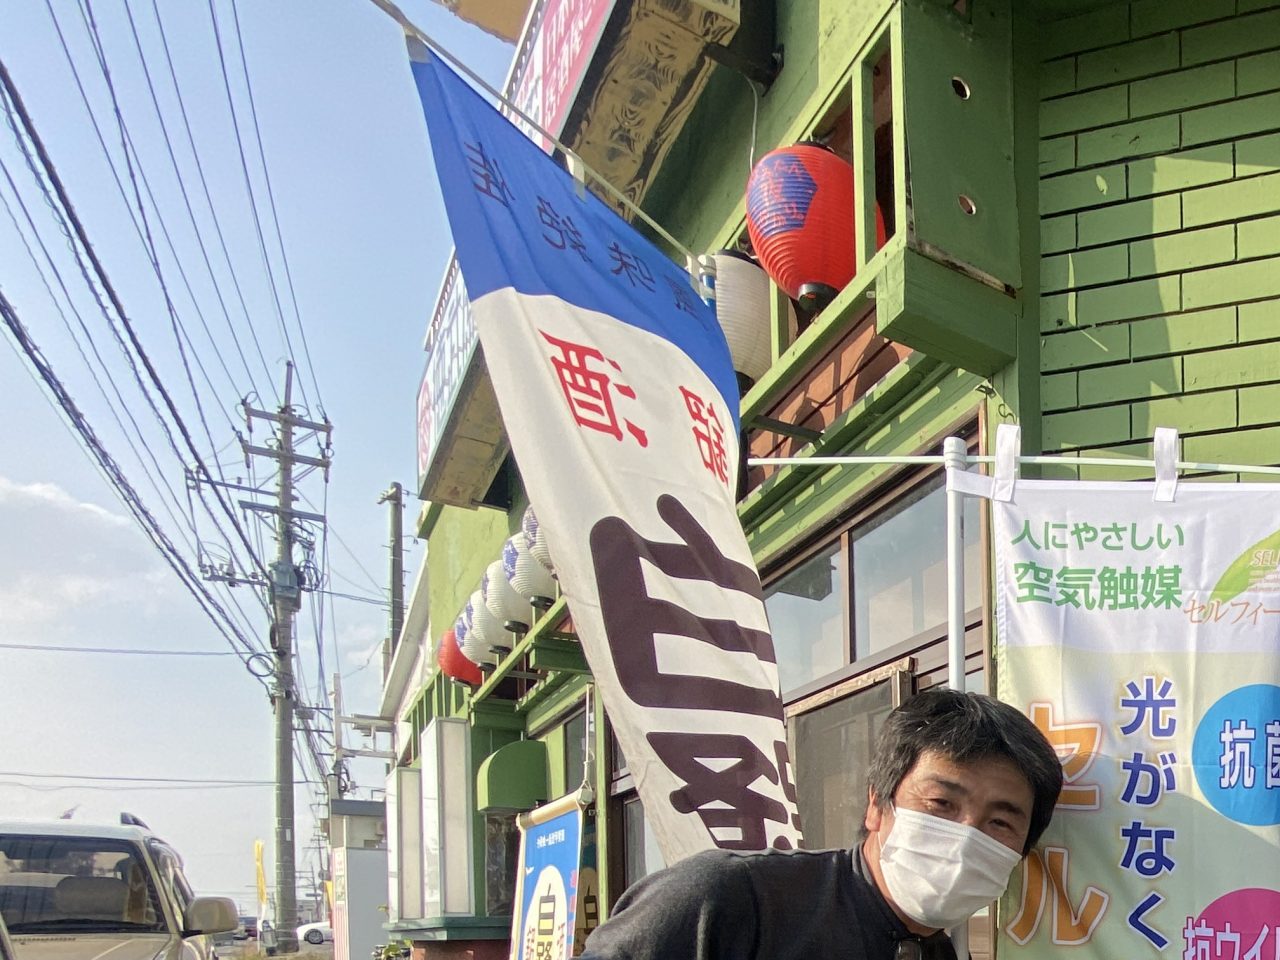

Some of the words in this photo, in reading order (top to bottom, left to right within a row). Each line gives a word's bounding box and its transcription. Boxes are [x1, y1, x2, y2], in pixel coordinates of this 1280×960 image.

[1011, 519, 1184, 551] 人にやさしい
[1013, 561, 1183, 611] 空気触媒
